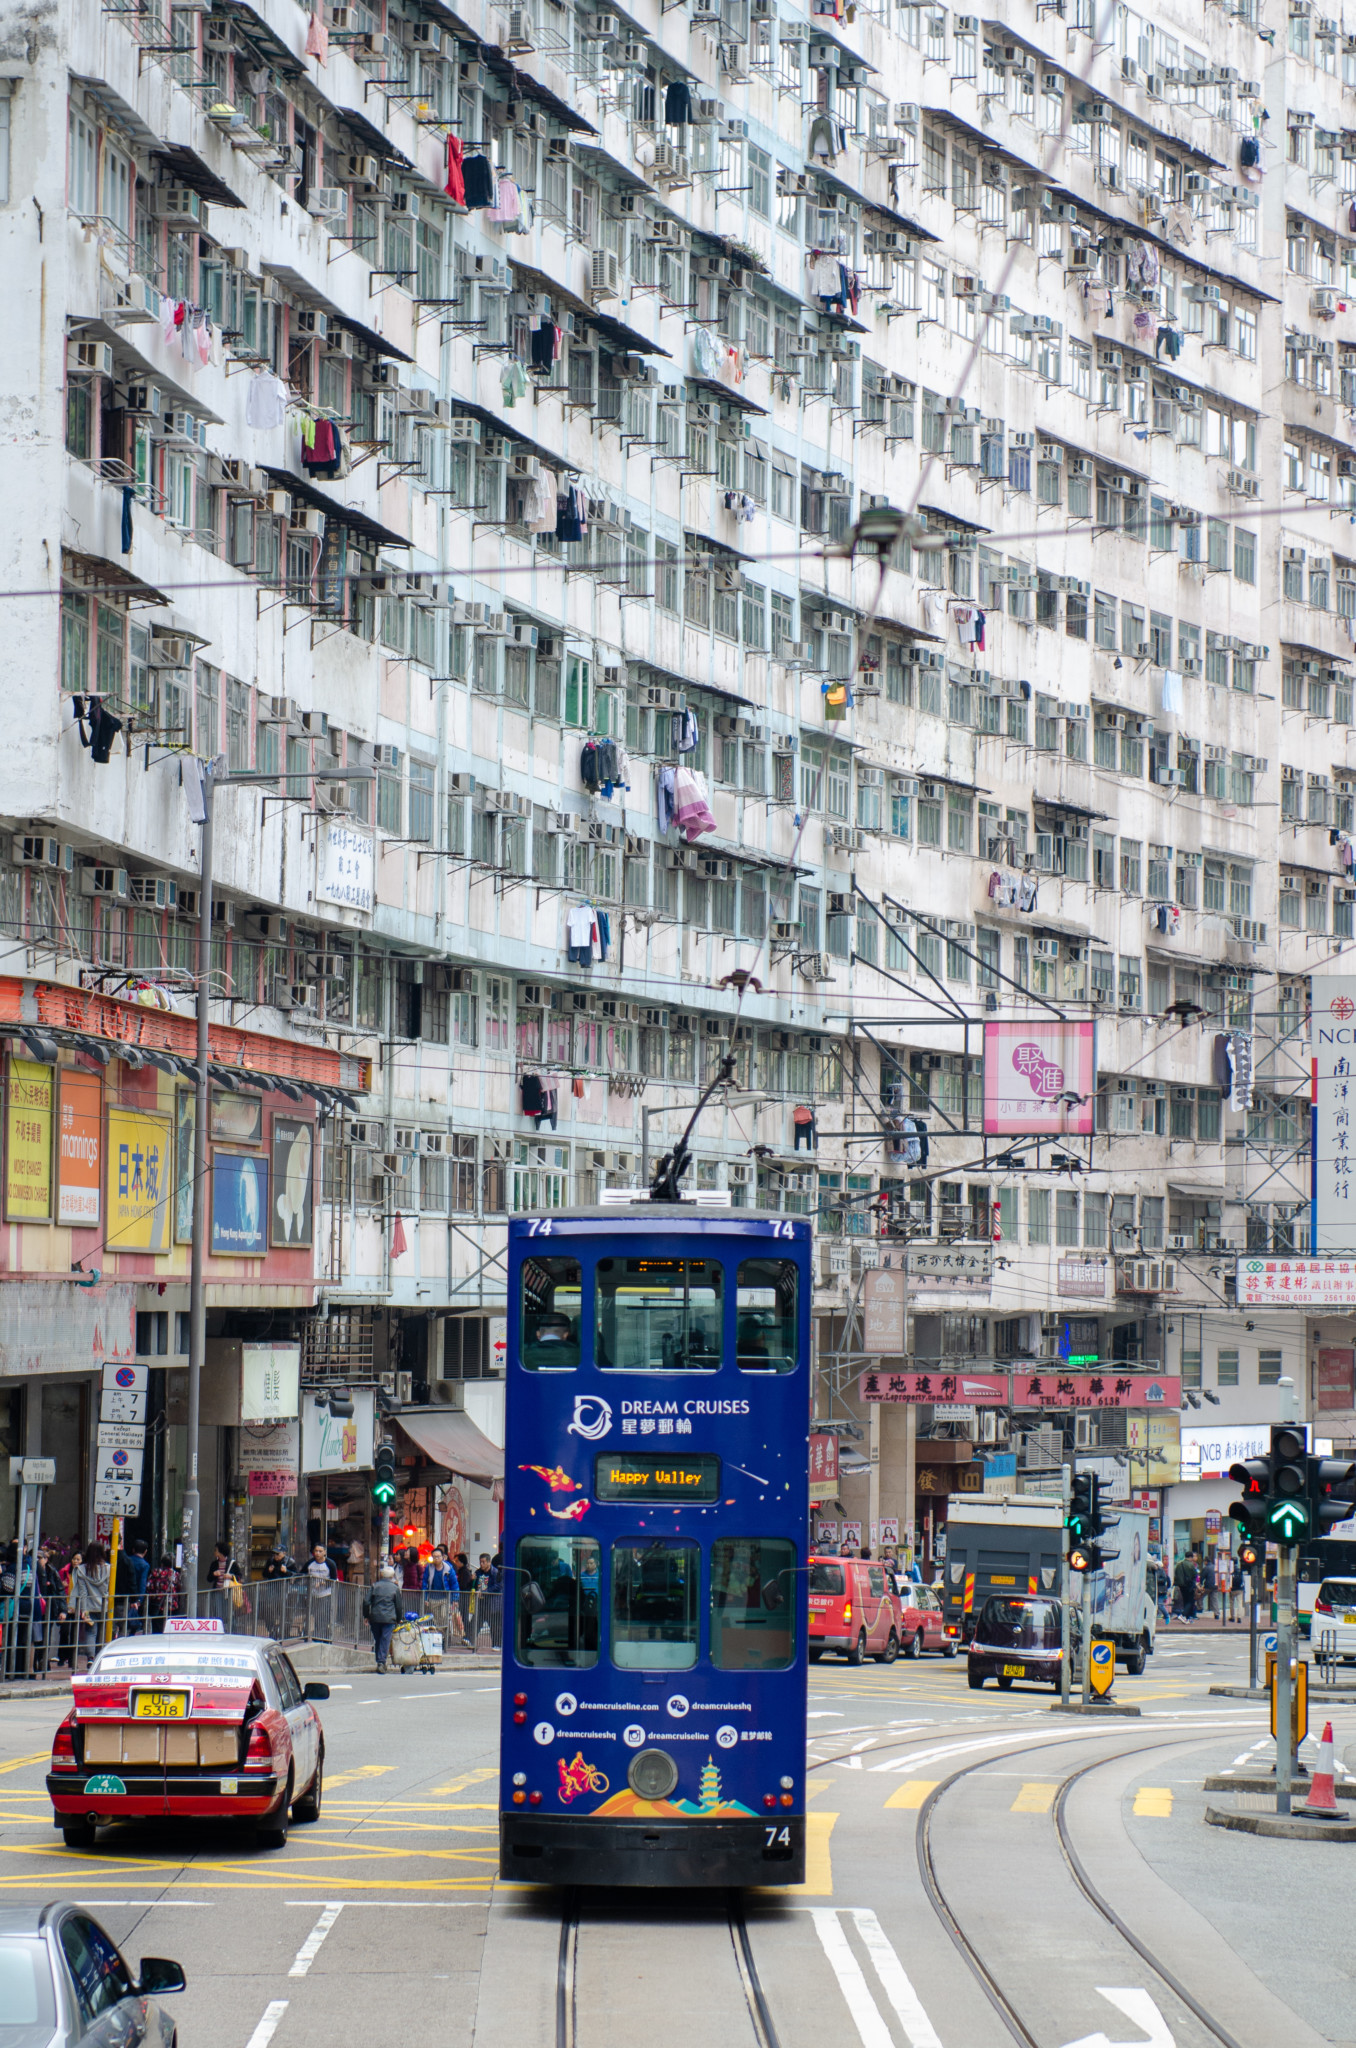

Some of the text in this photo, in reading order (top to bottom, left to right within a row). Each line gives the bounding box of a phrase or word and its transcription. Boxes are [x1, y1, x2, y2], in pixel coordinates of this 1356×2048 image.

[1319, 1029, 1356, 1044] NC
[1332, 1056, 1353, 1199] 南洋商業銀行
[61, 1129, 98, 1168] mannings
[118, 1143, 160, 1201] 日本城
[527, 1218, 552, 1237] 74
[769, 1219, 795, 1239] 74
[1266, 1263, 1356, 1273] 鰂魚涌居民協
[1311, 1280, 1356, 1290] 議員辦事
[131, 1394, 139, 1404] 7
[1070, 1397, 1092, 1406] 2516
[621, 1400, 750, 1415] DREAM CRUISES
[130, 1410, 137, 1421] 7
[621, 1418, 693, 1435] 星夢郵輪
[341, 1429, 357, 1462] One
[1202, 1443, 1221, 1461] NCB
[610, 1469, 702, 1486] Happy Valley
[124, 1486, 132, 1497] 7
[123, 1504, 137, 1515] 12
[170, 1620, 218, 1632] TAXI
[151, 1694, 171, 1706] UB
[579, 1701, 752, 1711] dreamcruiseline.com dreamcruiseshq
[142, 1705, 179, 1717] 5318
[556, 1729, 616, 1740] dreamcruiseshq
[647, 1731, 710, 1740] dreamcruiseline
[101, 1779, 110, 1788] 4
[765, 1826, 791, 1847] 74
